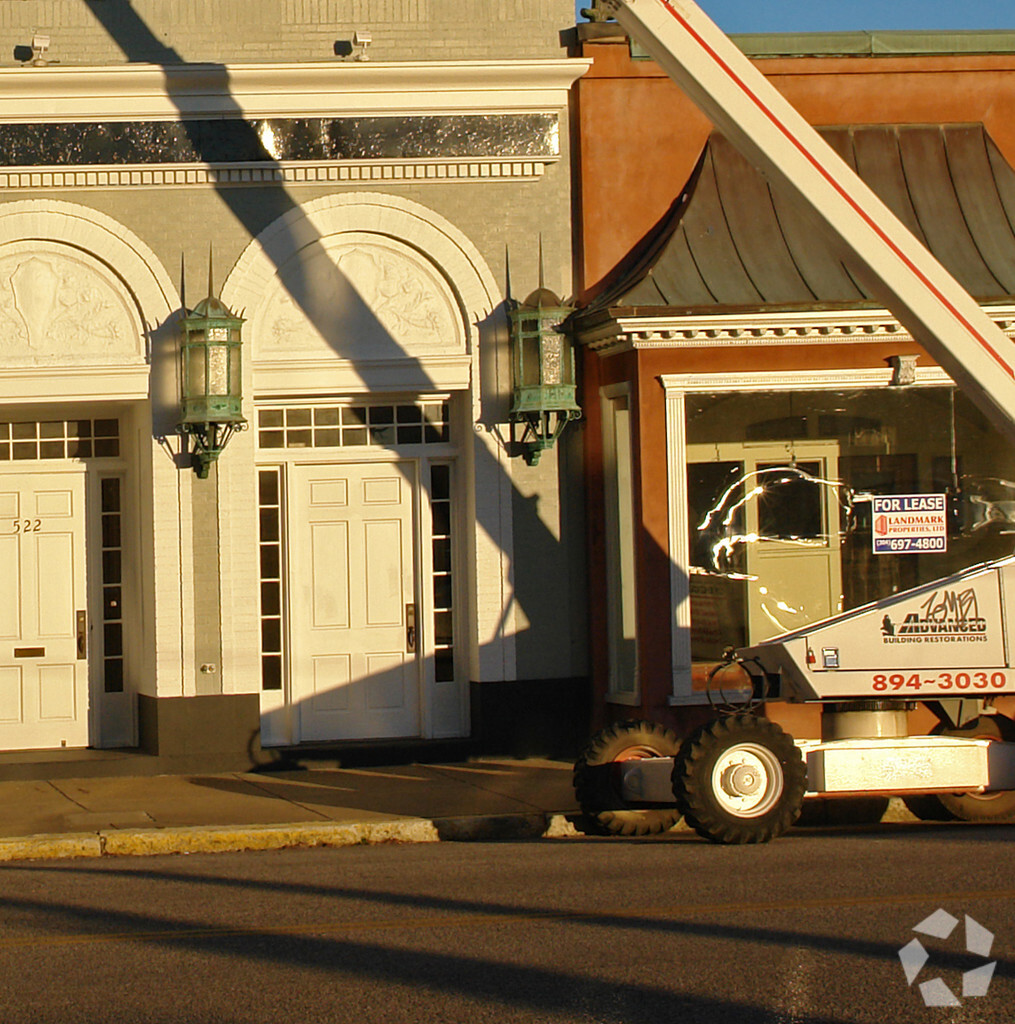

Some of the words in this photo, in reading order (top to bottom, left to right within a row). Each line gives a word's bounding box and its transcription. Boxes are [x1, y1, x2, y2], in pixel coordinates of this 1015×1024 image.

[875, 499, 901, 511] FOR
[904, 497, 943, 510] LEASE
[13, 519, 41, 534] 522
[889, 516, 944, 524] LANDMARK
[898, 613, 987, 633] ADVANCED
[883, 636, 922, 644] BUILDING
[924, 635, 988, 643] RESTORATIONS
